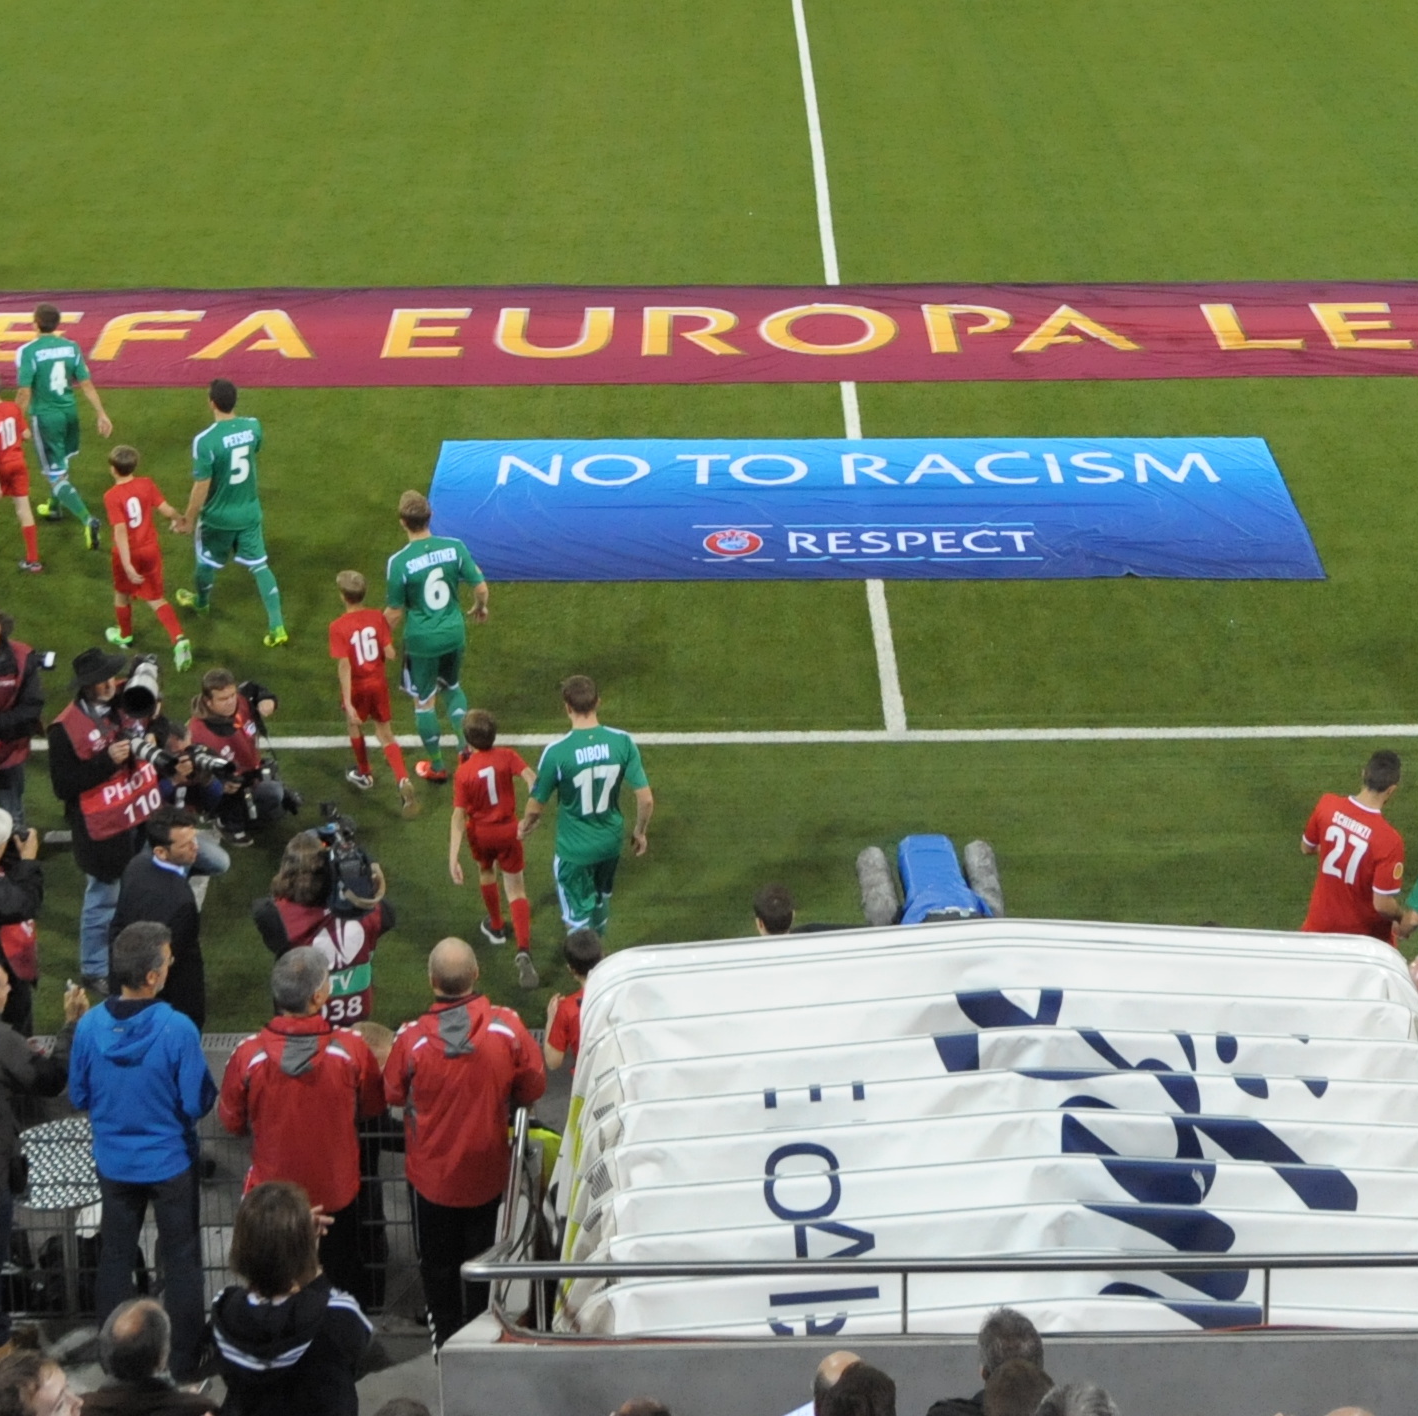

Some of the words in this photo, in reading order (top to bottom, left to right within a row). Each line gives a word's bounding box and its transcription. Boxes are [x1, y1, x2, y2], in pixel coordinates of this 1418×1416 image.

[380, 302, 1142, 360] EUROPA
[49, 361, 68, 396] 4
[229, 445, 250, 485] 5
[496, 453, 651, 486] NO
[675, 452, 809, 485] TO
[839, 450, 1223, 484] RACISM
[126, 496, 143, 529] 9
[787, 530, 1035, 554] RESPECT
[424, 567, 450, 610] 6
[349, 626, 379, 666] 16
[575, 743, 610, 765] DIBON
[124, 788, 161, 824] 110
[477, 766, 499, 806] 7
[572, 764, 621, 816] 17
[1322, 825, 1369, 885] 27
